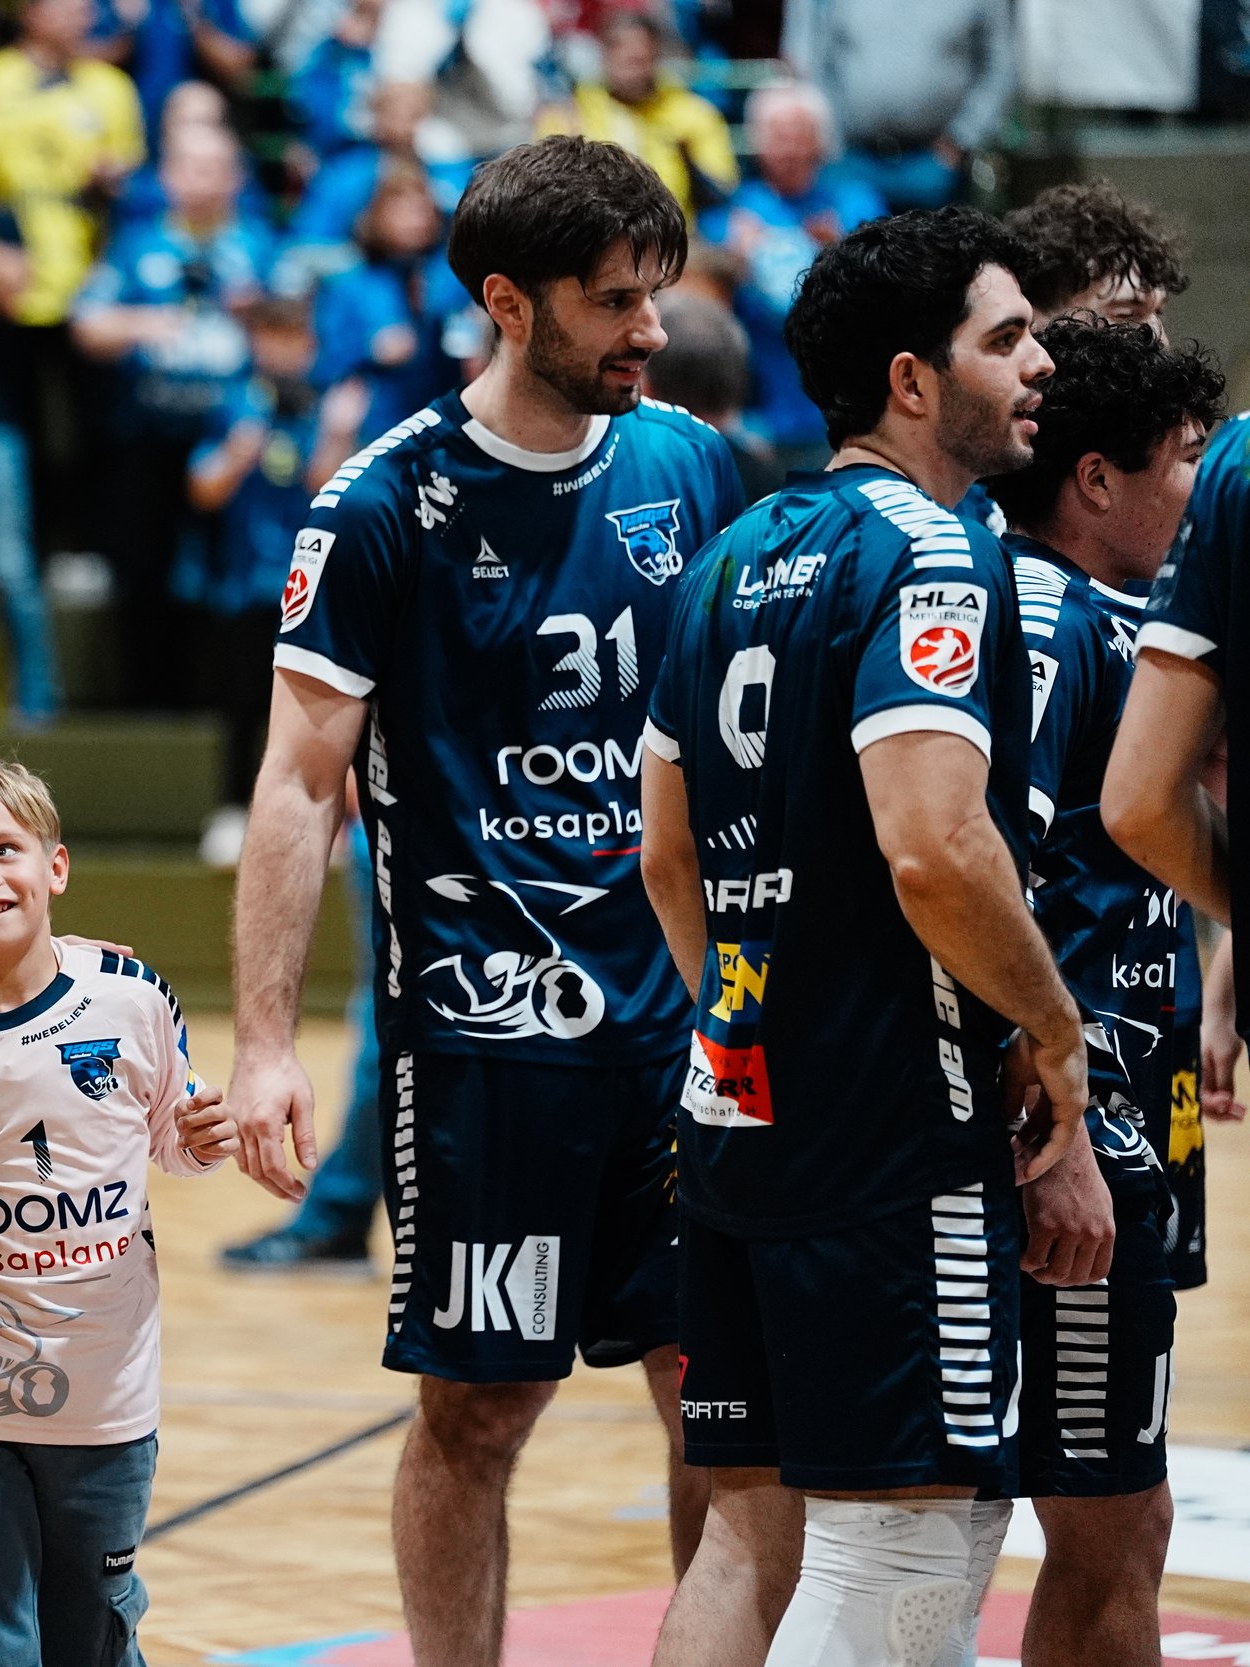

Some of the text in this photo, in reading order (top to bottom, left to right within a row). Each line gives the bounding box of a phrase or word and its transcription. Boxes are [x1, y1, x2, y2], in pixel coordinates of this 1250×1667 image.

[297, 536, 322, 553] LA
[471, 564, 510, 579] SELECT
[910, 590, 981, 611] HLA
[535, 605, 640, 712] 31
[478, 800, 643, 845] kosapla
[1112, 952, 1176, 989] ksal
[20, 996, 92, 1046] #WEBELIEVE
[937, 1037, 974, 1123] we
[20, 1119, 54, 1185] 1
[432, 1240, 550, 1335] JK CONSULTING
[1137, 1351, 1172, 1445] J
